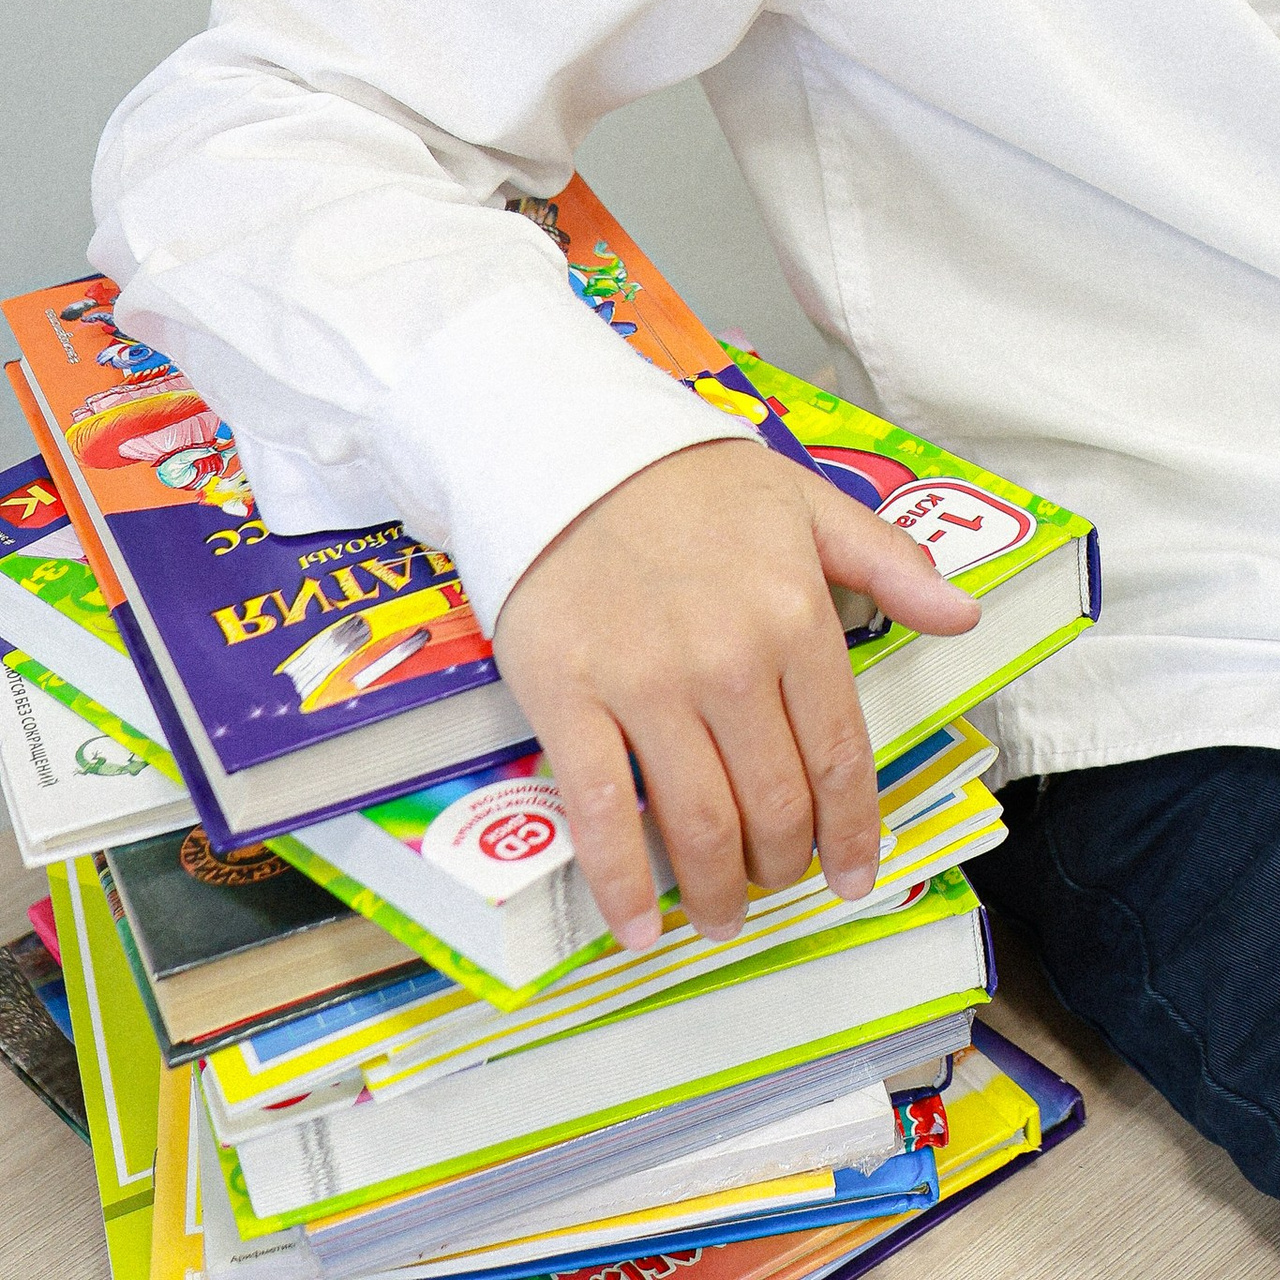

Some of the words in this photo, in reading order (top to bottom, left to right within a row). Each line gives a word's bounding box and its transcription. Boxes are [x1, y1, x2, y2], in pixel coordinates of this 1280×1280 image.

[3, 665, 25, 697] ЮТСЯ
[15, 697, 33, 716] БЕЗ
[21, 717, 60, 789] СОКРАЩЕНИЙ
